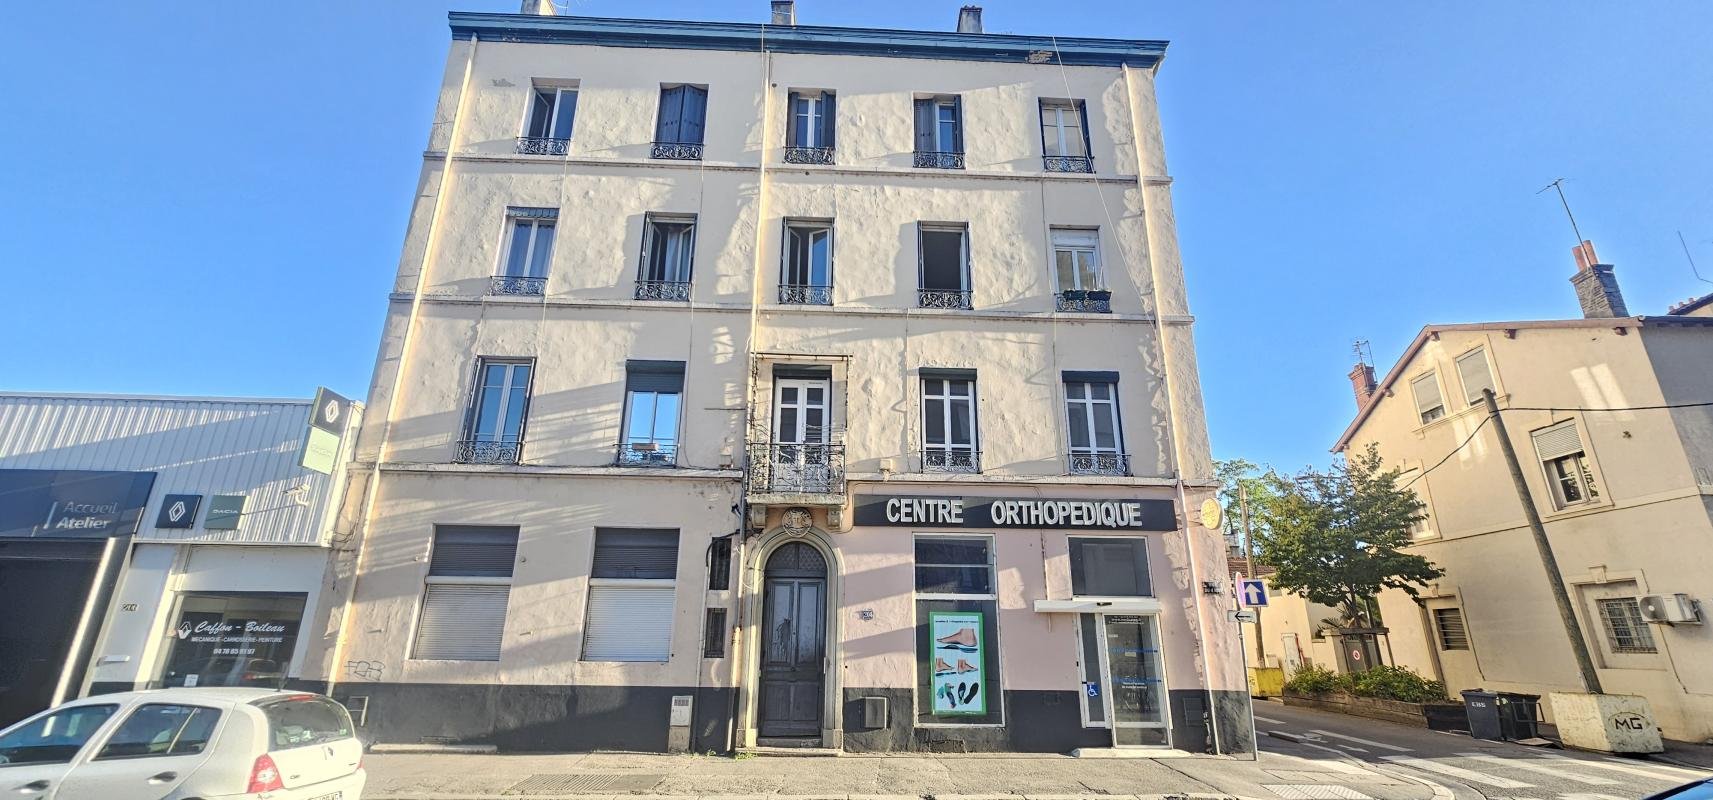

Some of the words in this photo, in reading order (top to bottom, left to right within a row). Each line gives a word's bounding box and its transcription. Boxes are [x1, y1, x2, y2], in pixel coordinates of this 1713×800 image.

[63, 501, 120, 515] Accueil
[886, 498, 964, 524] CENTRE
[990, 500, 1143, 528] ORTHOPEDIQUE
[56, 516, 112, 529] Atelier
[195, 621, 233, 634] Caffon
[245, 621, 286, 632] Boileau
[1614, 717, 1643, 730] MG
